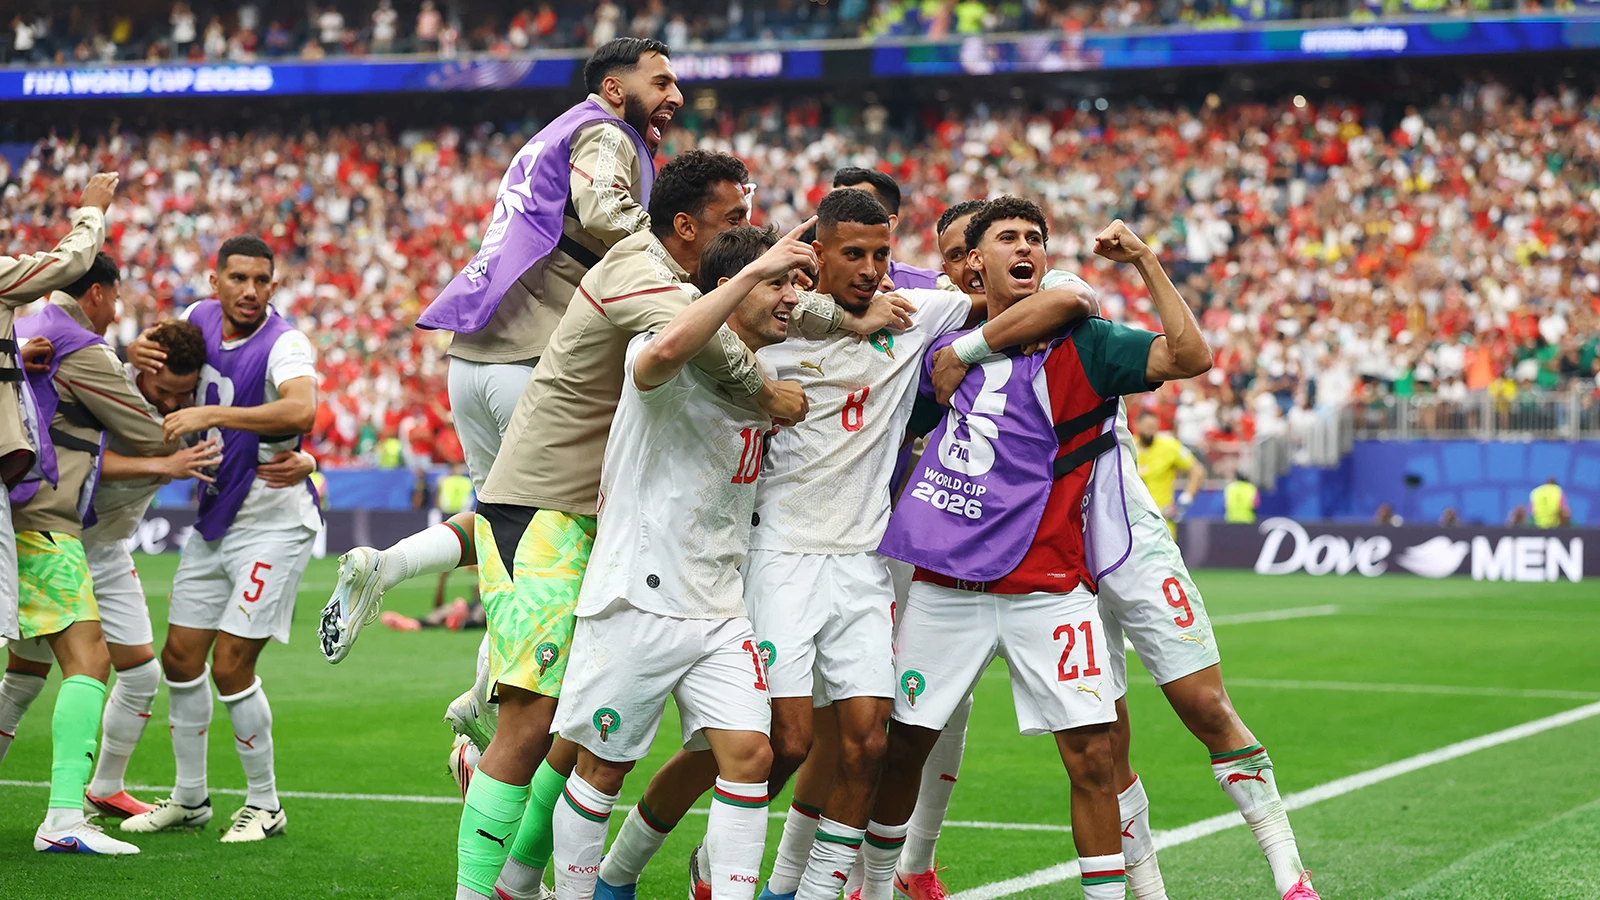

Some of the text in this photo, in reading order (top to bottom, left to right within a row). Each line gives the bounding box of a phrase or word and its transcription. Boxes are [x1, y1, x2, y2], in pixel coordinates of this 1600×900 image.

[22, 70, 71, 95] FIFA
[70, 69, 149, 94] WORLD
[150, 67, 195, 92] CUP
[841, 386, 870, 432] 8
[731, 428, 763, 484] 10
[924, 466, 962, 491] WORLD
[911, 481, 982, 520] 2026
[1254, 516, 1584, 583] Dove MEN
[243, 561, 272, 602] 5
[1162, 576, 1195, 629] 9
[1053, 621, 1101, 681] 21
